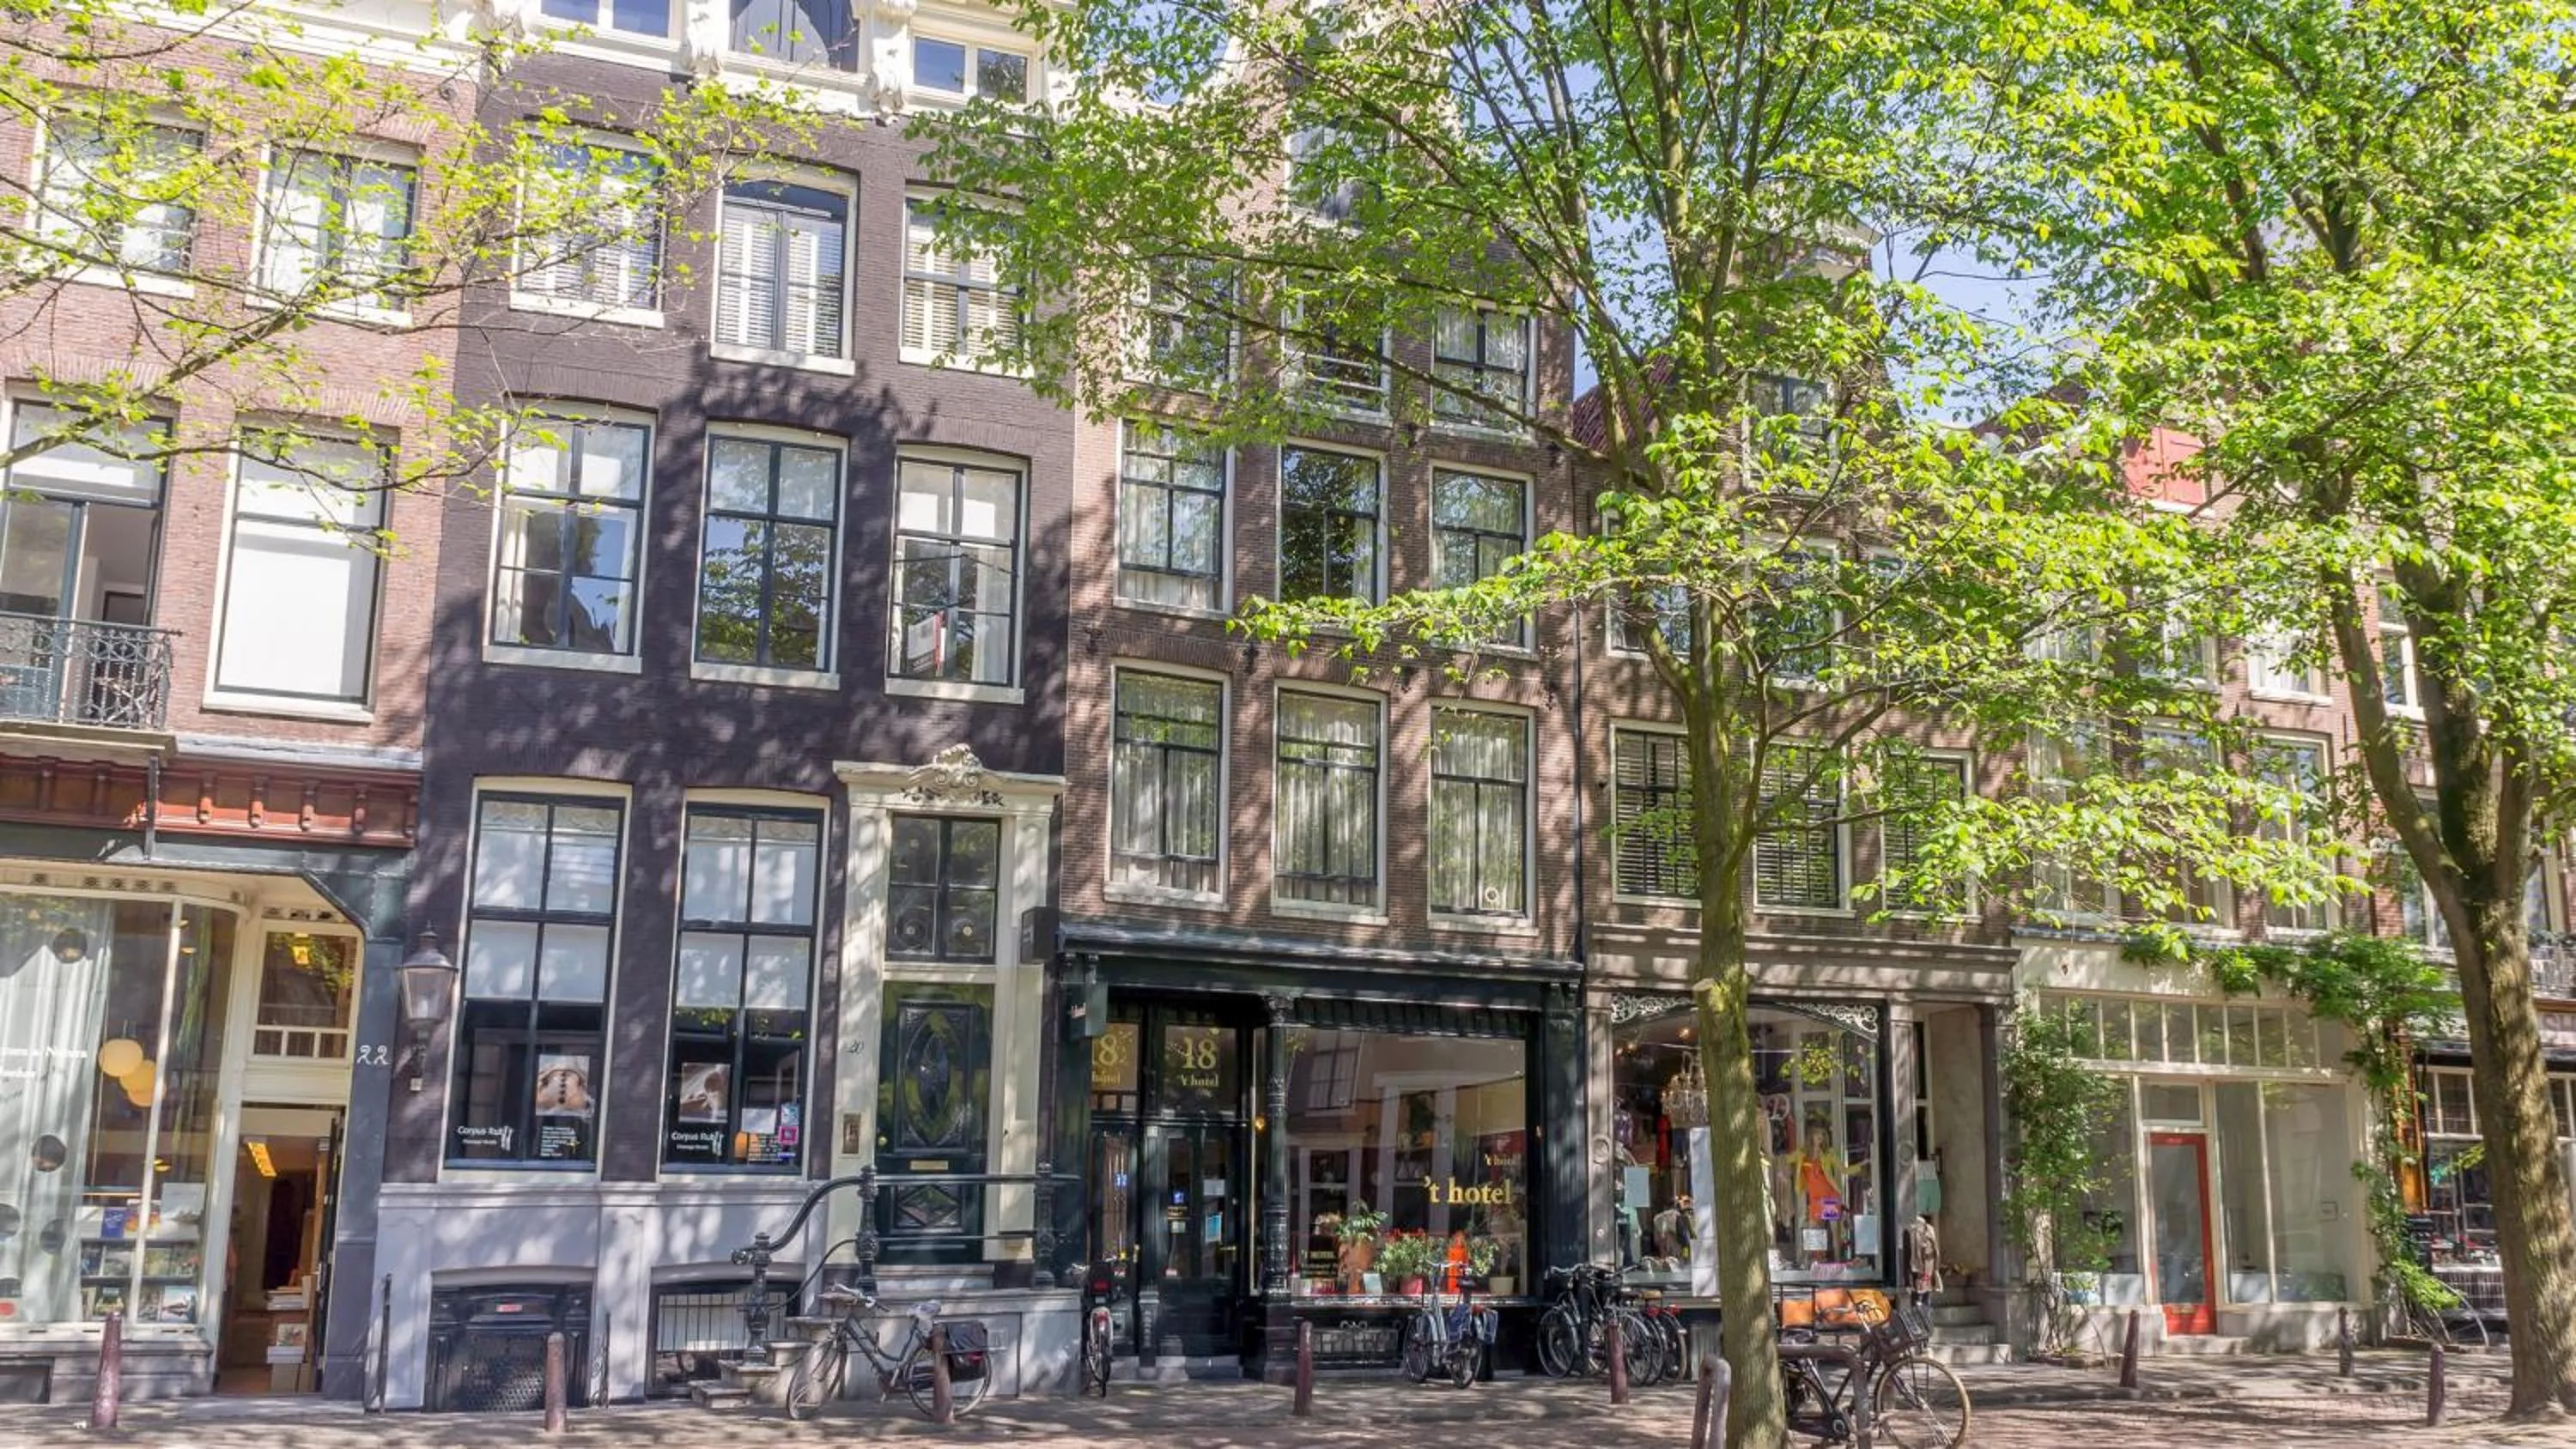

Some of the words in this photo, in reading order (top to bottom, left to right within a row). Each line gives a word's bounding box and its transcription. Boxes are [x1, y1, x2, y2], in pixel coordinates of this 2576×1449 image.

[357, 1045, 388, 1065] 22
[1182, 1036, 1217, 1070] 18
[1424, 1175, 1440, 1203] 't
[1448, 1177, 1511, 1203] hotel
